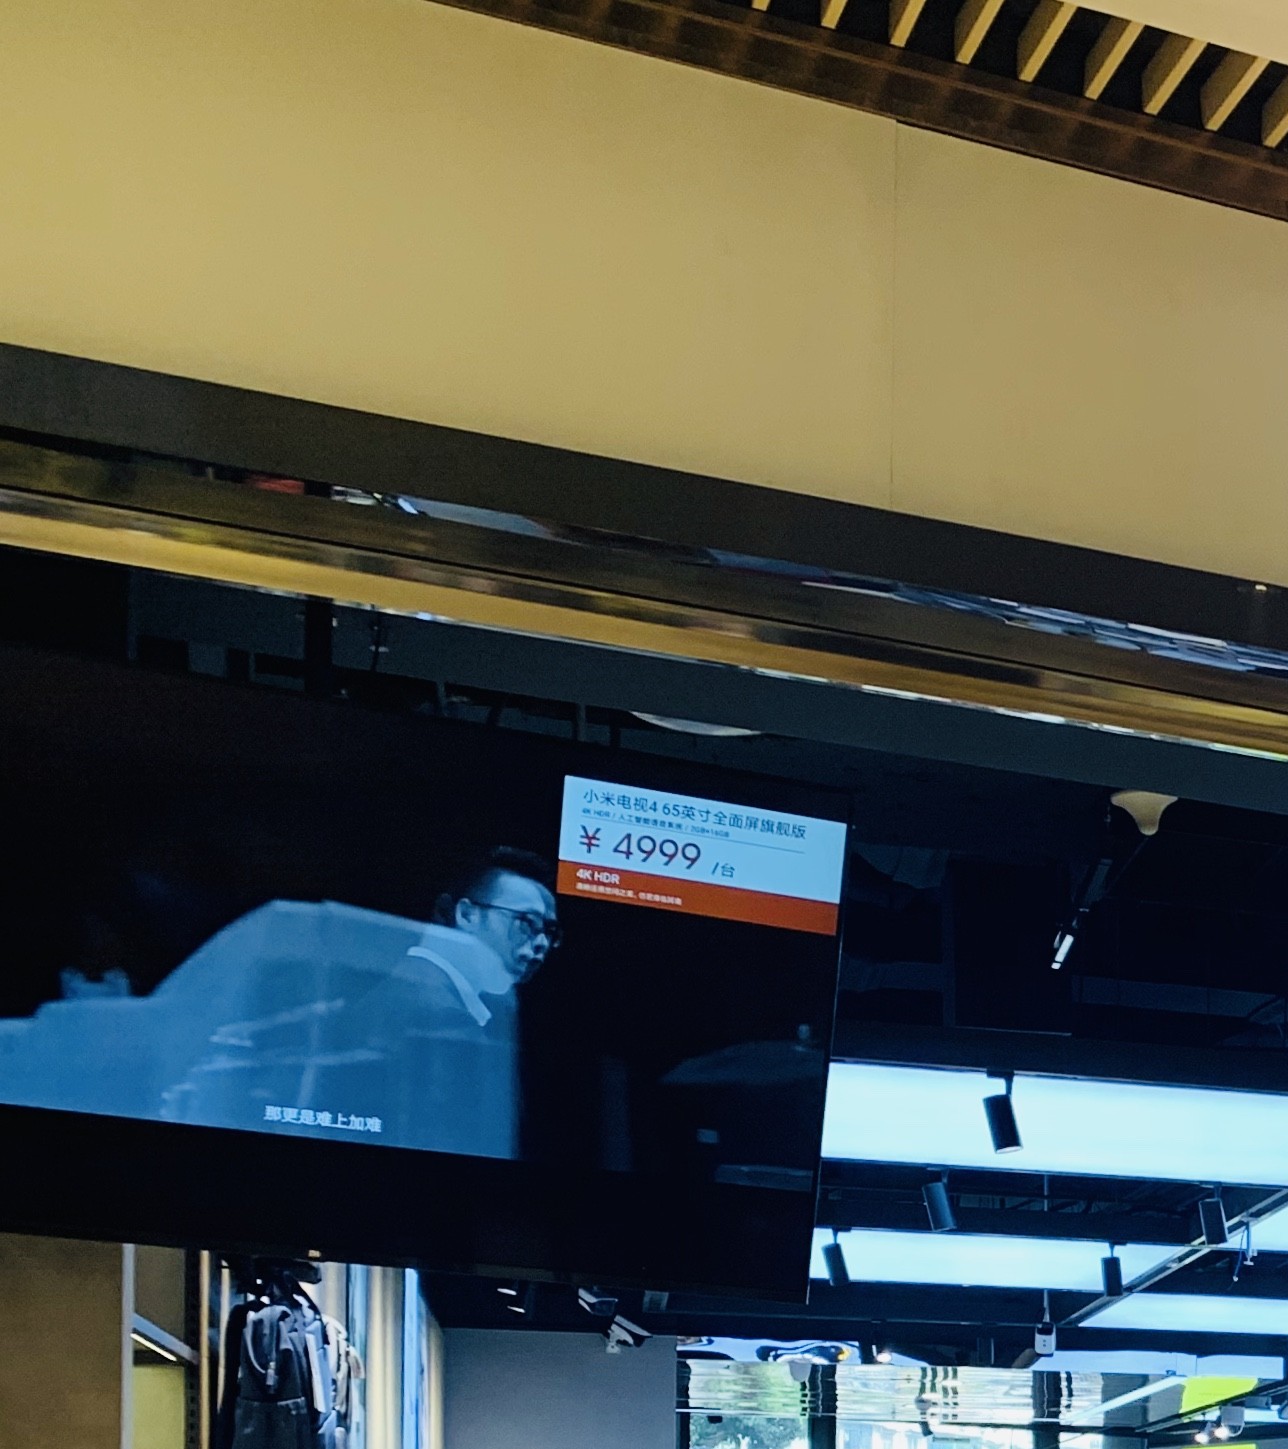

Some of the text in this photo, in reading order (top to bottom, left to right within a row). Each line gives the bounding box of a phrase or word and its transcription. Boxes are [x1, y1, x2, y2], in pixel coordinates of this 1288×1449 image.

[583, 788, 807, 839] 小米电视4 65英寸全面屏旗舰版
[612, 832, 702, 870] 4999
[576, 868, 621, 885] 4K HDR
[263, 1105, 382, 1133] 那更是难上加难
